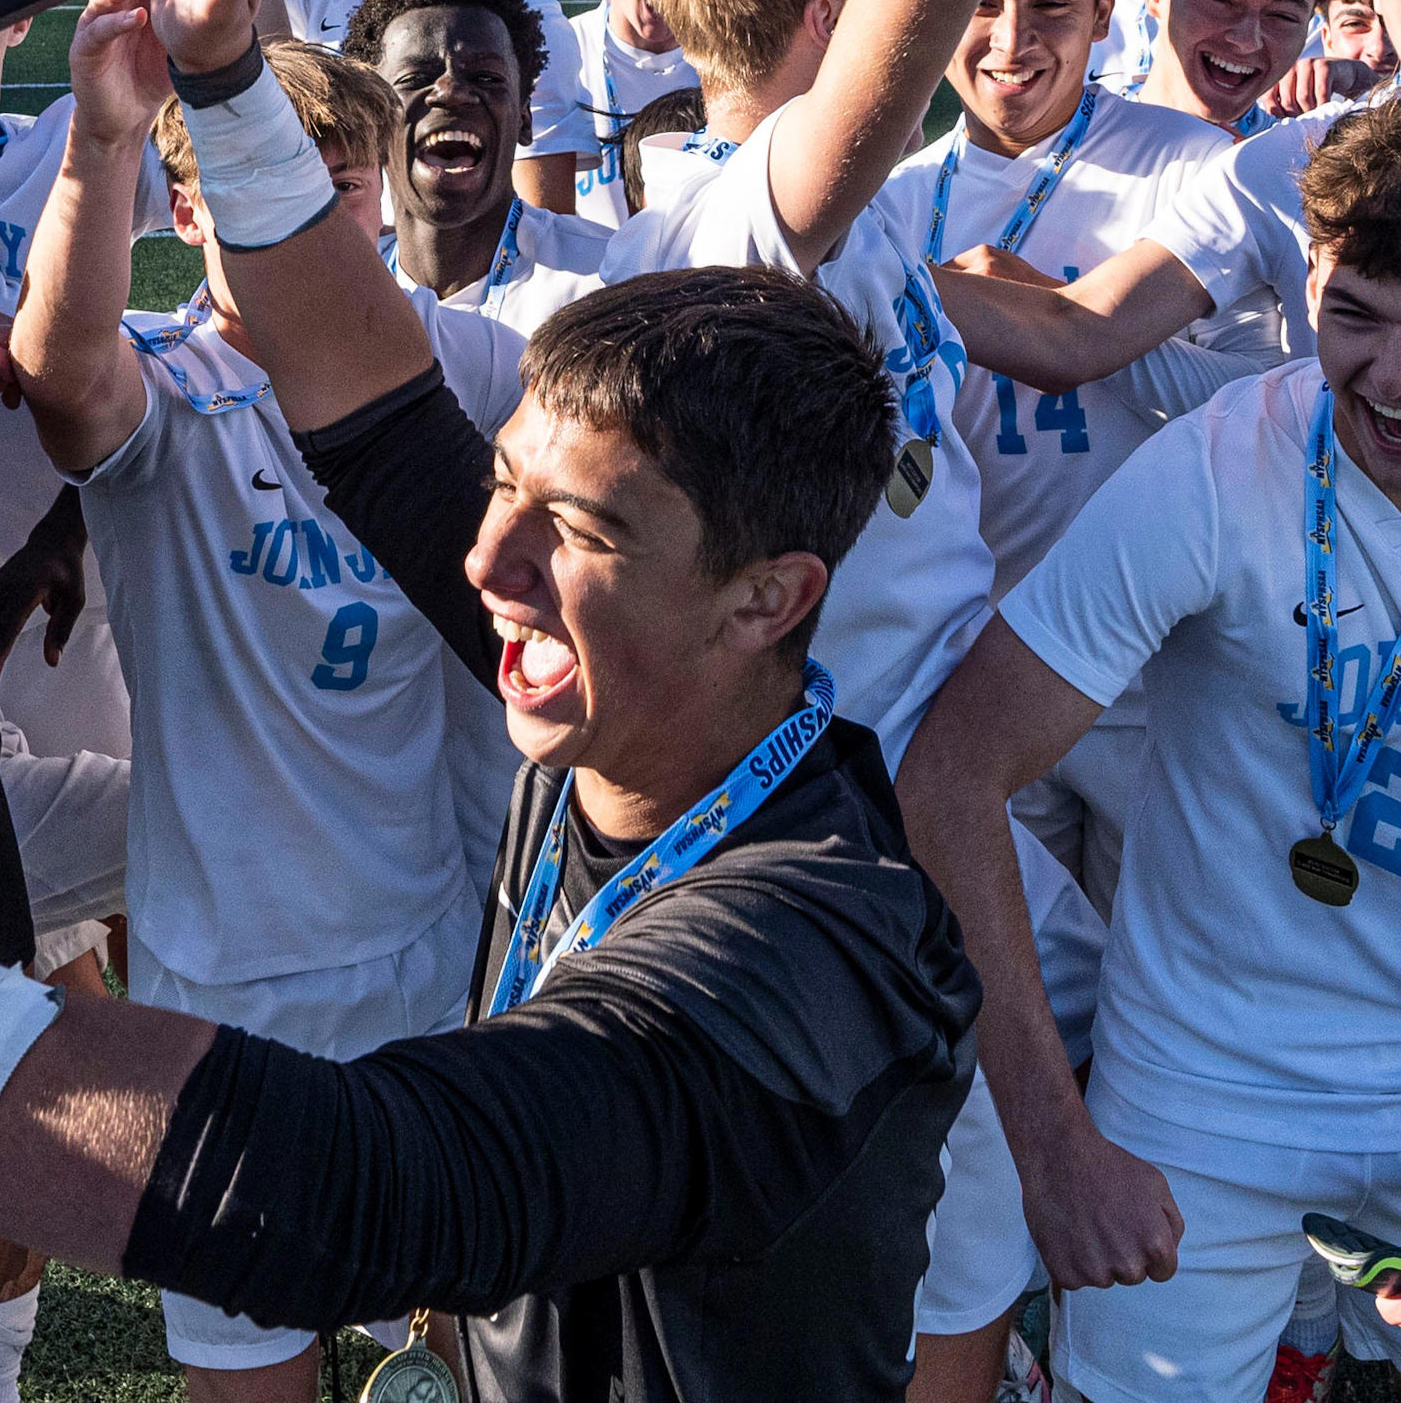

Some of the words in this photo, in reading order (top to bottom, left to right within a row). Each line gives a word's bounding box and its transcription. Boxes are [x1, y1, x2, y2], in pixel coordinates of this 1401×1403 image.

[992, 372, 1090, 455] 14
[310, 601, 379, 691] 9
[674, 805, 726, 856] NYSPHSAA
[605, 867, 656, 917] NYSPHSAA
